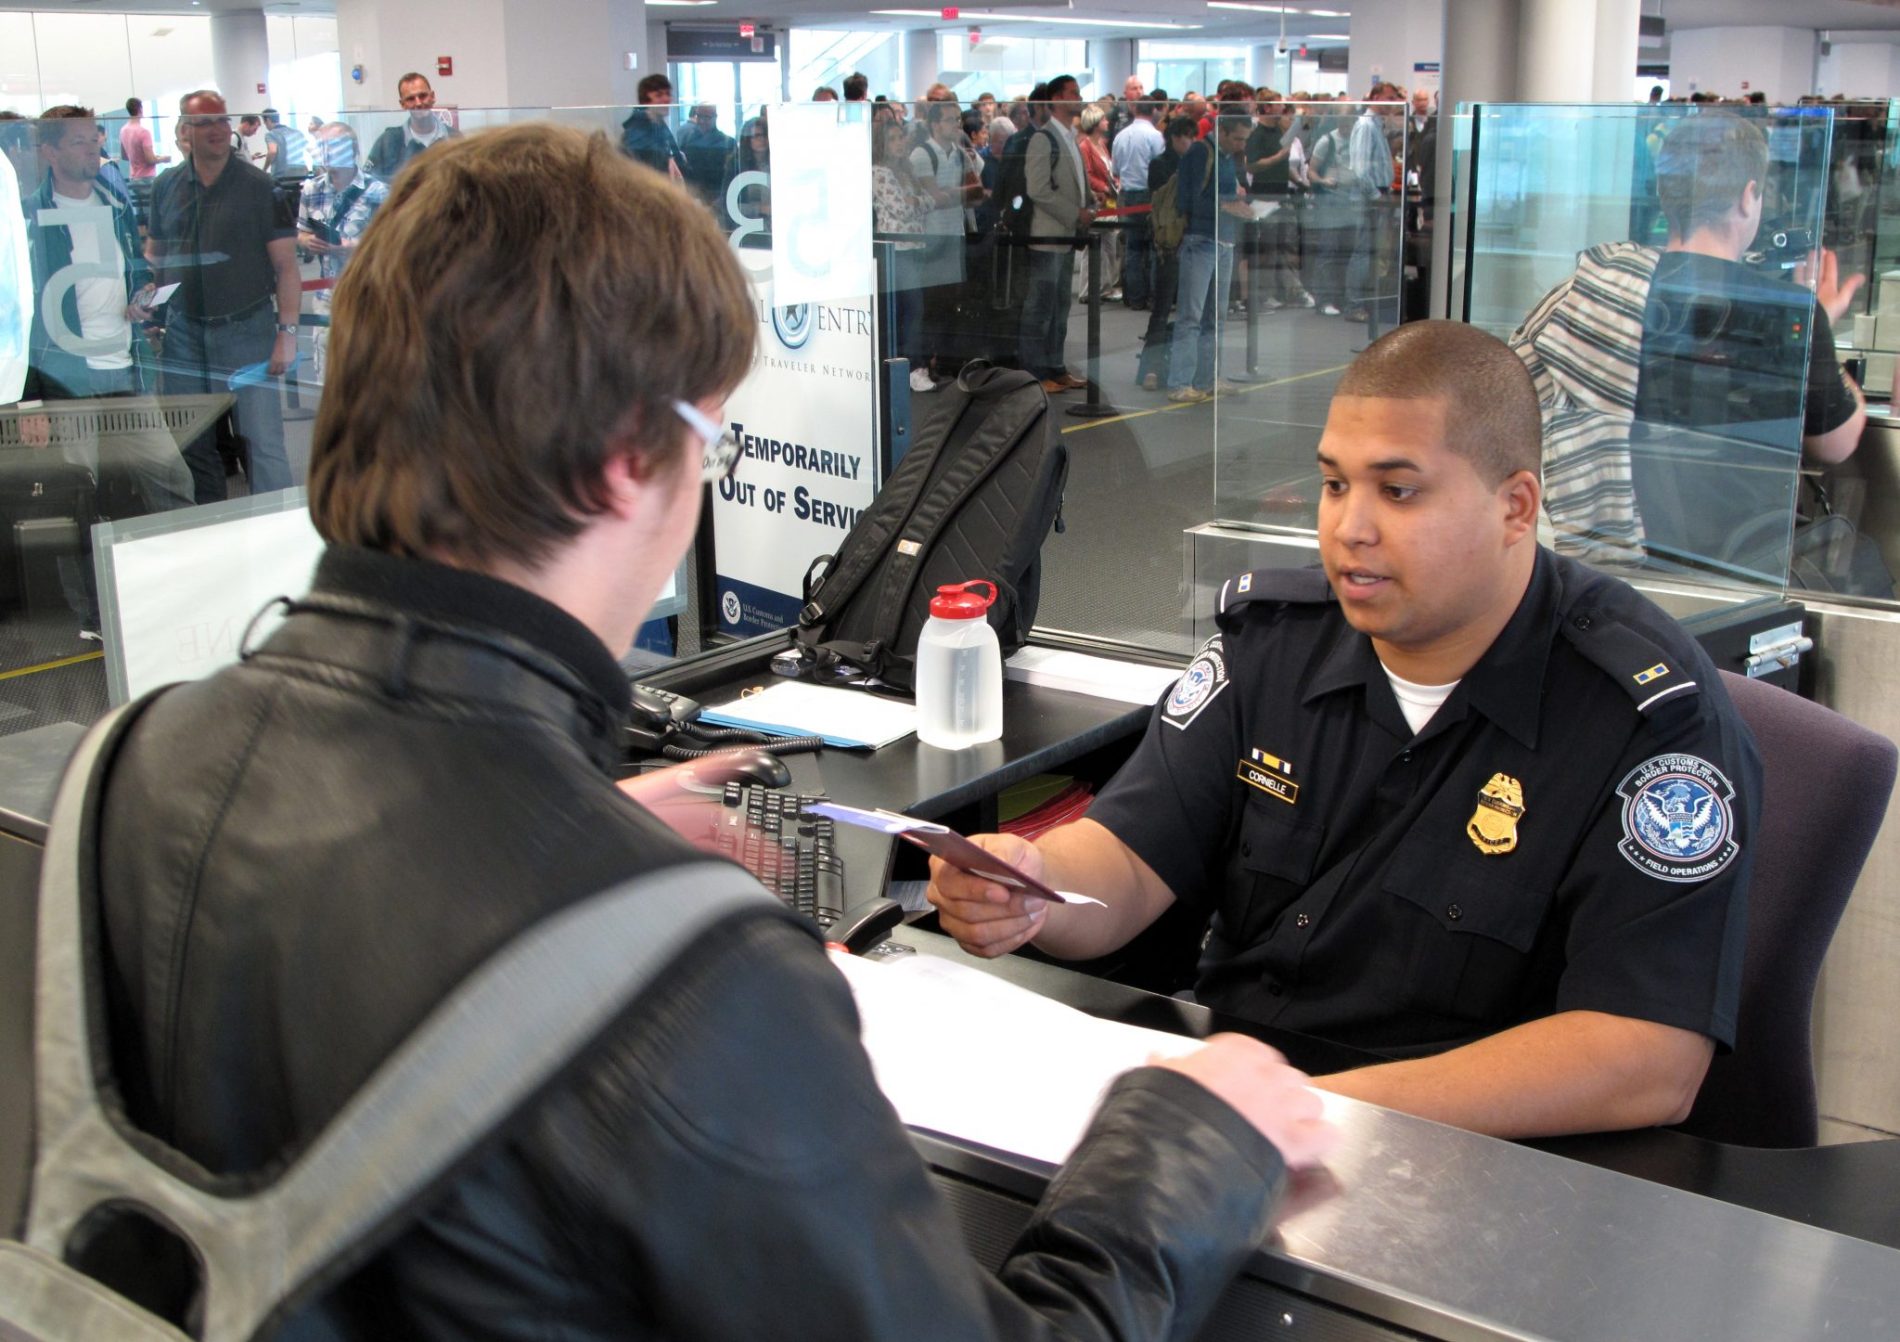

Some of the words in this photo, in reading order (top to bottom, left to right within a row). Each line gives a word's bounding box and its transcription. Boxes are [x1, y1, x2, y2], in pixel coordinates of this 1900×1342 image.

[817, 305, 871, 336] ENTR
[763, 355, 816, 374] TRAVELER
[822, 364, 870, 382] NETWOR
[731, 422, 861, 480] TEMPORARILY
[718, 473, 756, 507] OUT
[763, 488, 786, 514] OF
[793, 485, 864, 530] SERVI
[1635, 765, 1668, 787] BORDER
[1670, 765, 1718, 787] PROTECTION
[1640, 762, 1657, 774] U.S.
[1659, 758, 1699, 768] CUSTOMS
[1700, 766, 1712, 775] AND
[1248, 769, 1287, 795] CORNIELLE
[1645, 859, 1668, 873] FIELD
[1670, 860, 1718, 876] OPERATIONS
